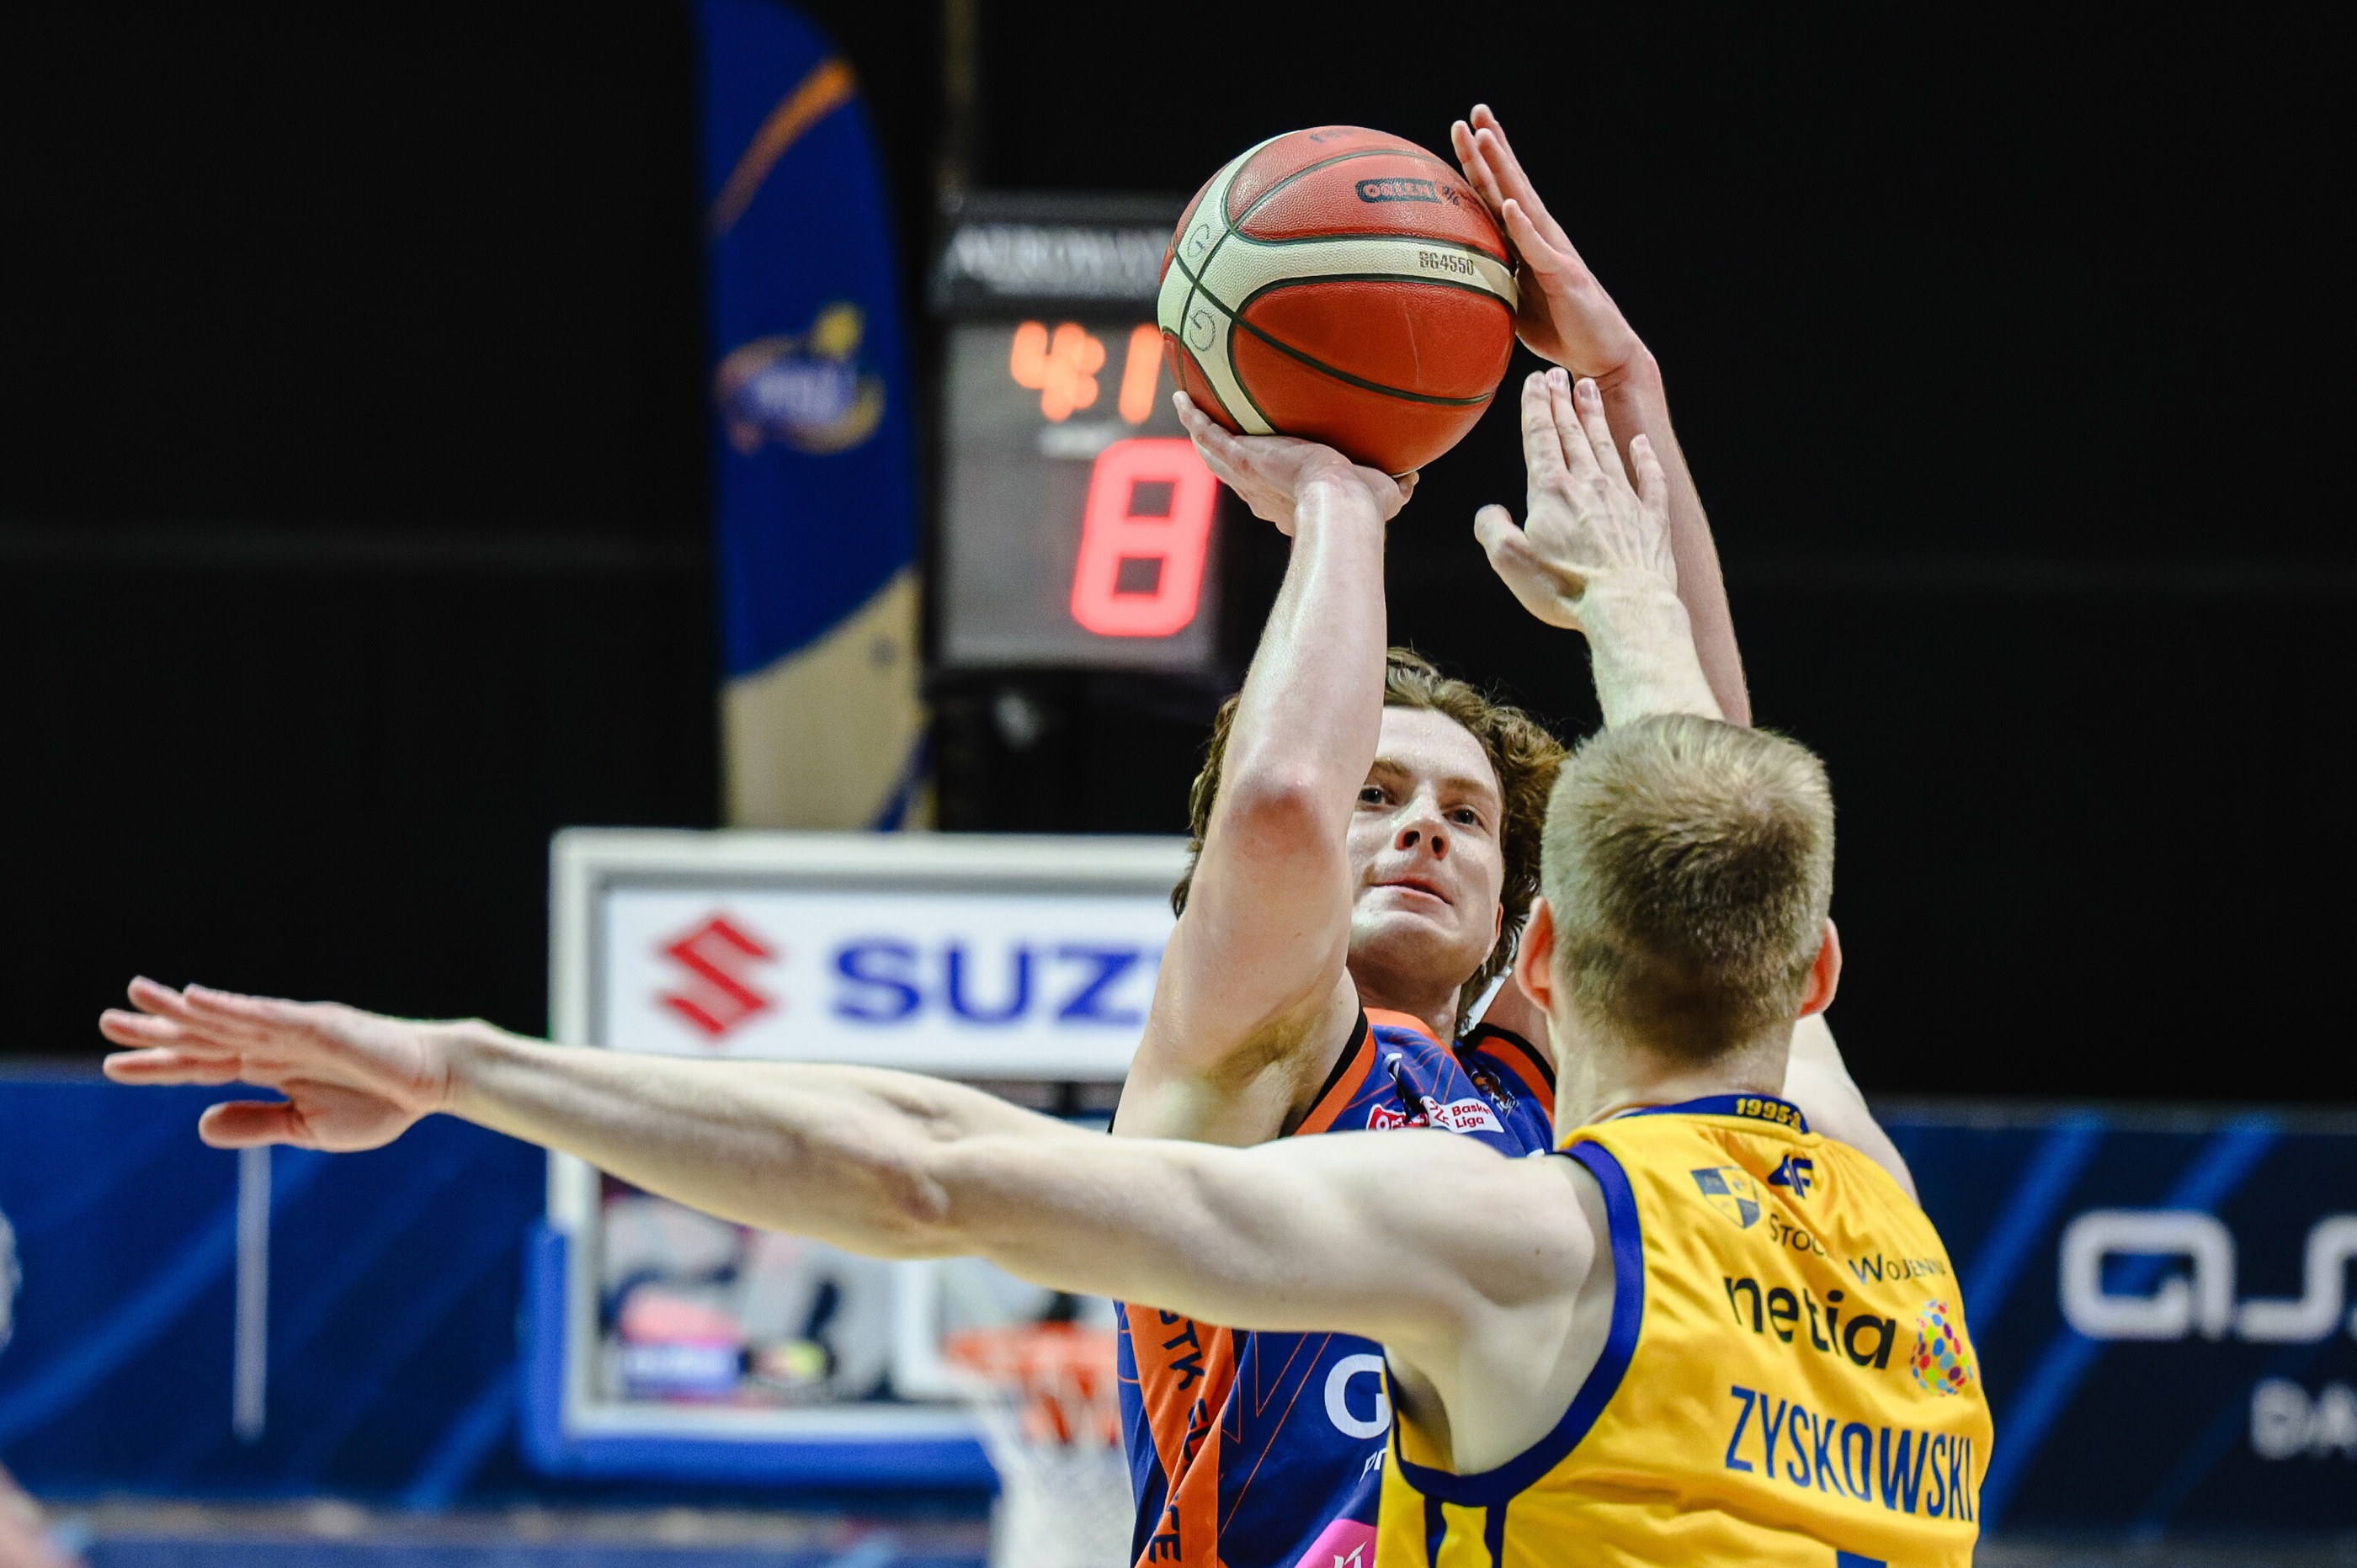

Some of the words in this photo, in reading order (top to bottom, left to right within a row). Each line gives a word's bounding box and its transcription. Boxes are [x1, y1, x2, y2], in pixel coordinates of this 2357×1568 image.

[1419, 252, 1474, 276] BG4550
[1010, 321, 1164, 423] 4:1
[1070, 438, 1218, 637] 8
[831, 937, 1157, 1028] SUZ
[1451, 1103, 1492, 1117] Bask
[1455, 1117, 1484, 1129] Liga
[1724, 1276, 1897, 1369] netia
[1725, 1385, 1973, 1522] ZYSKOWSKI
